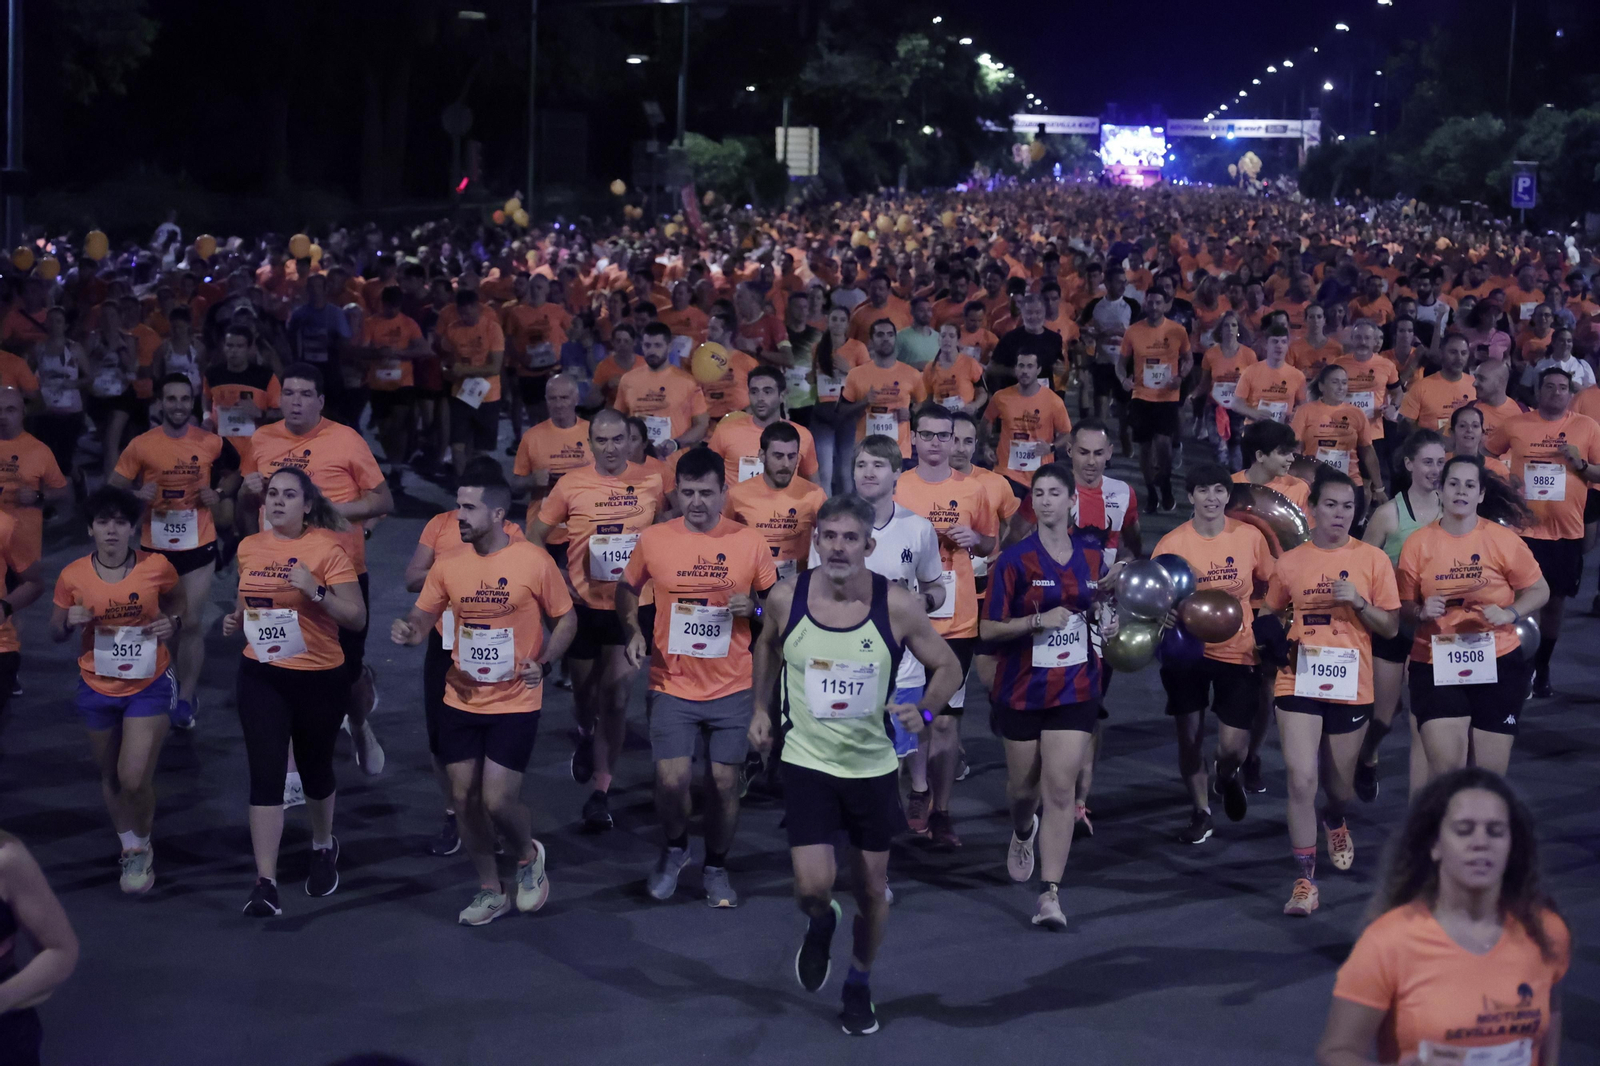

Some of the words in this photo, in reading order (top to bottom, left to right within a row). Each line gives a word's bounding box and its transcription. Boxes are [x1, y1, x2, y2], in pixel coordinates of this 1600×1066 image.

[1518, 177, 1530, 192] P
[1533, 475, 1555, 486] 9882
[163, 523, 187, 534] 4355
[693, 564, 729, 572] NOCTURNA
[1206, 567, 1238, 576] NOCTURNA
[248, 570, 276, 578] SEVILLA
[676, 570, 708, 578] SEVILLA
[709, 571, 728, 579] KH7
[1198, 574, 1222, 583] EVILLA
[1222, 573, 1238, 581] KH7
[1465, 571, 1482, 579] KH7
[1303, 588, 1332, 596] SEVILLA
[460, 596, 490, 604] SEVILLA
[491, 597, 509, 605] KH7
[105, 605, 143, 614] NOCTURNA
[122, 610, 142, 619] KH7
[258, 626, 287, 641] 2924
[684, 622, 721, 637] 20383
[1047, 631, 1080, 647] 20904
[112, 643, 142, 657] 3512
[470, 647, 499, 661] 2923
[1447, 650, 1485, 663] 19508
[1311, 663, 1347, 678] 19509
[822, 678, 865, 696] 11517
